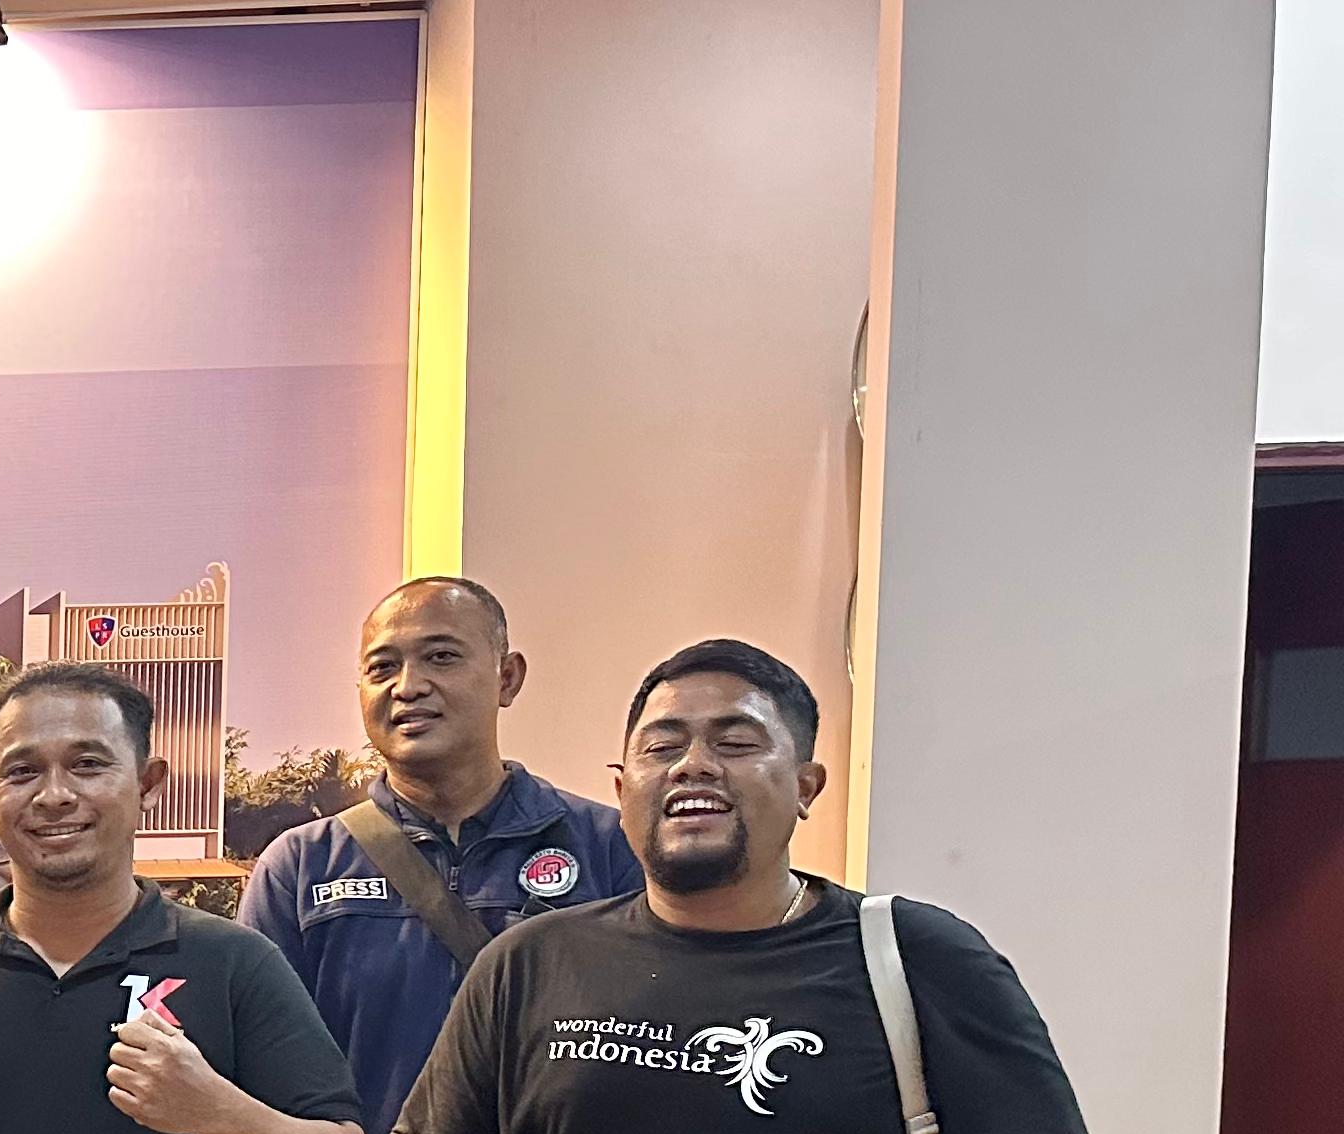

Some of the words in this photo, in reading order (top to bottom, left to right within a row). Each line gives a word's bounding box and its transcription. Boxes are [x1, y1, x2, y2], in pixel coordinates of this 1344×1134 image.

[120, 625, 205, 638] Guesthouse
[318, 880, 382, 902] PRESS
[553, 1017, 676, 1042] wonderful
[547, 1034, 717, 1073] indonesia
